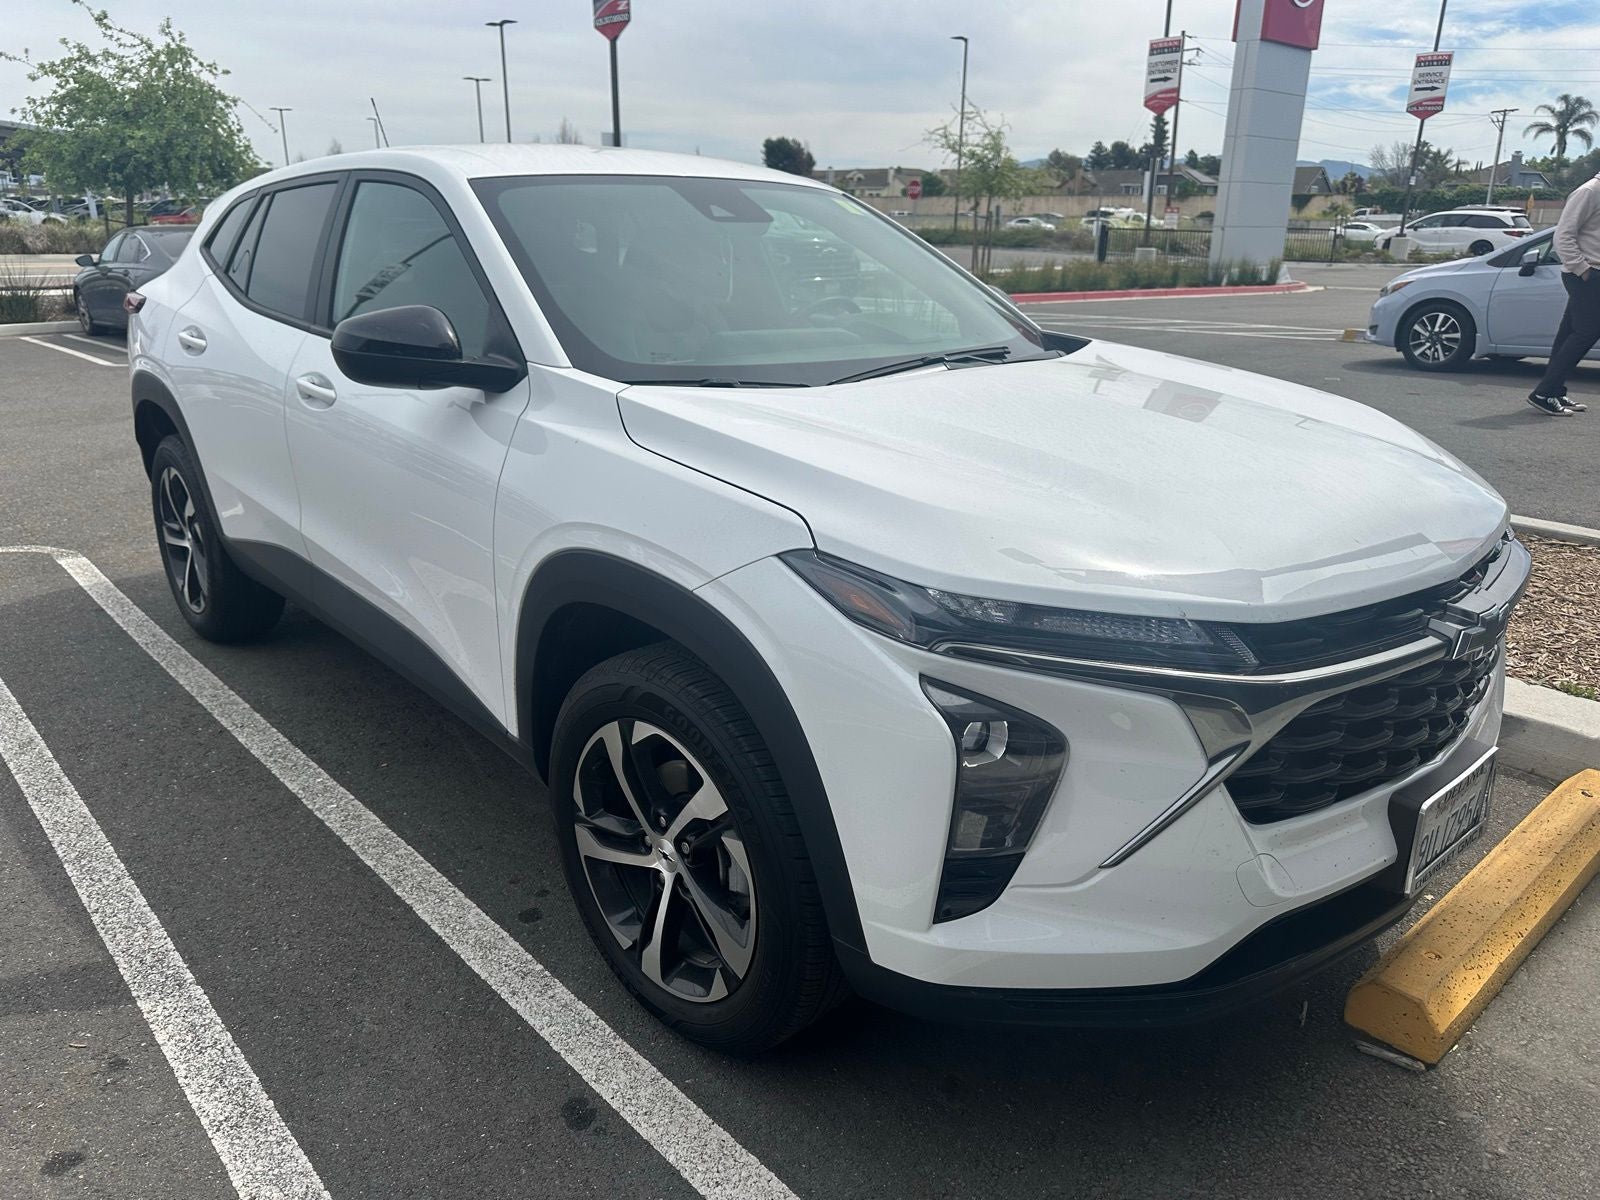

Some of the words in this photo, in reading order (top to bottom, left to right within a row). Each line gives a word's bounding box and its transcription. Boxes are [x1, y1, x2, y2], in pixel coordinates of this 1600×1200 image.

[1148, 60, 1178, 68] CUSTOMER
[1147, 67, 1178, 75] ENTRANCE
[1415, 850, 1456, 890] CHEVROLET
[1457, 829, 1480, 855] GMC
